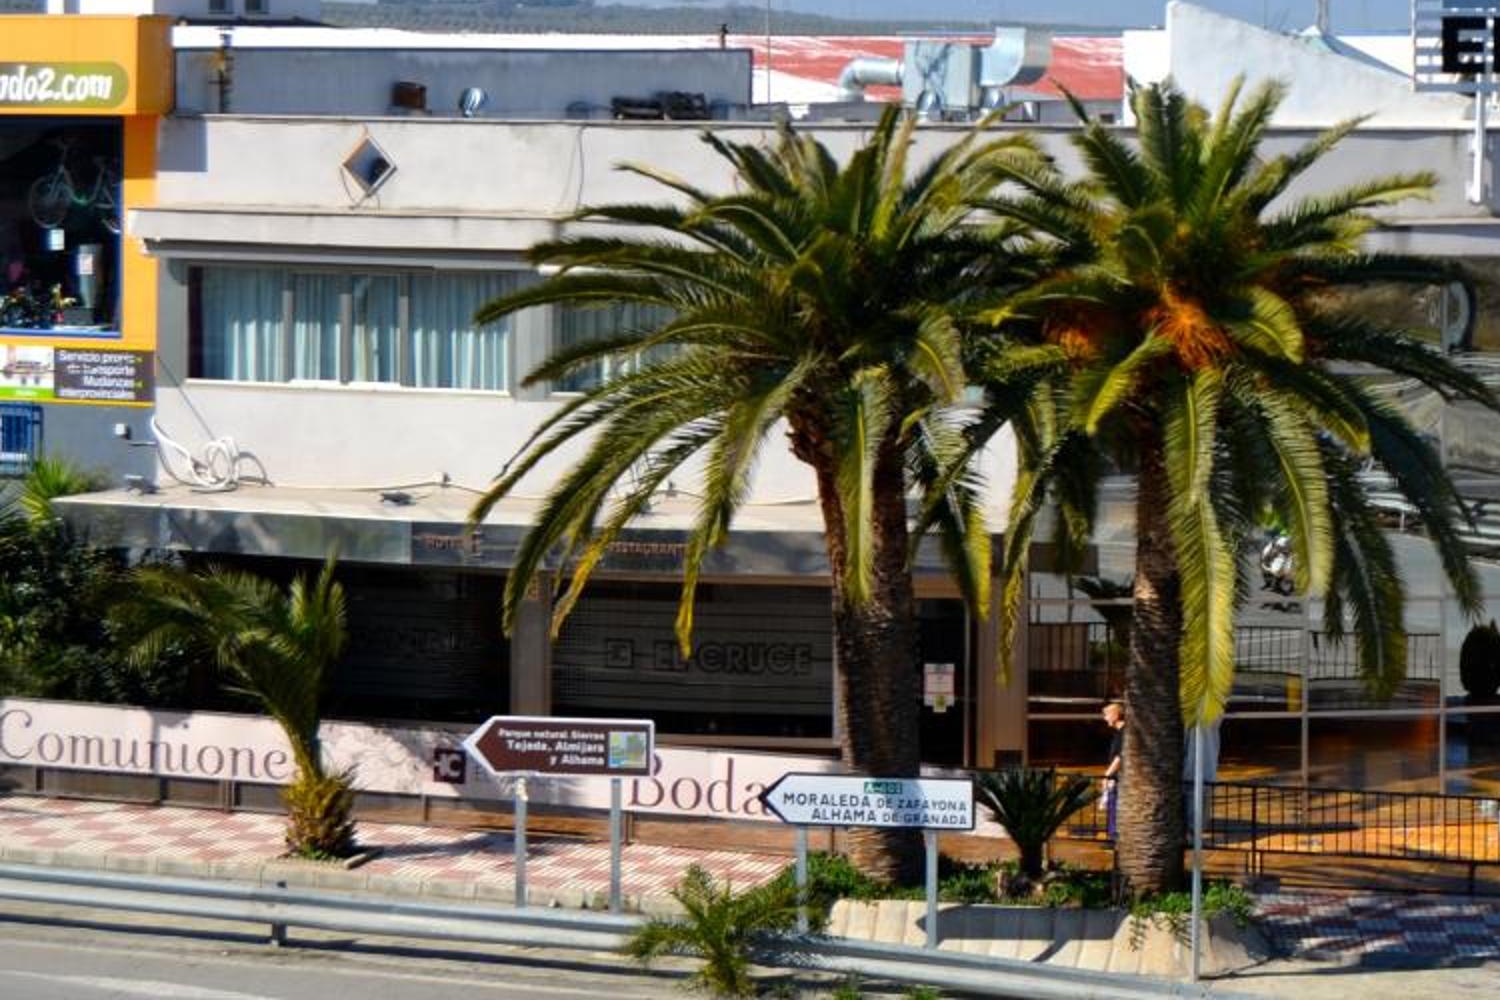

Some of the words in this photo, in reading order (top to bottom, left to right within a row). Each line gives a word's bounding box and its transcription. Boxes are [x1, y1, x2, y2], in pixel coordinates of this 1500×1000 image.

[698, 641, 815, 675] CRUCE
[0, 709, 303, 780] Comunione
[630, 754, 772, 817] Boda
[783, 792, 871, 808] MORALEDA
[877, 797, 894, 809] DE
[811, 807, 877, 822] ALHAMA
[883, 811, 898, 823] DE
[903, 813, 967, 825] GRANADA
